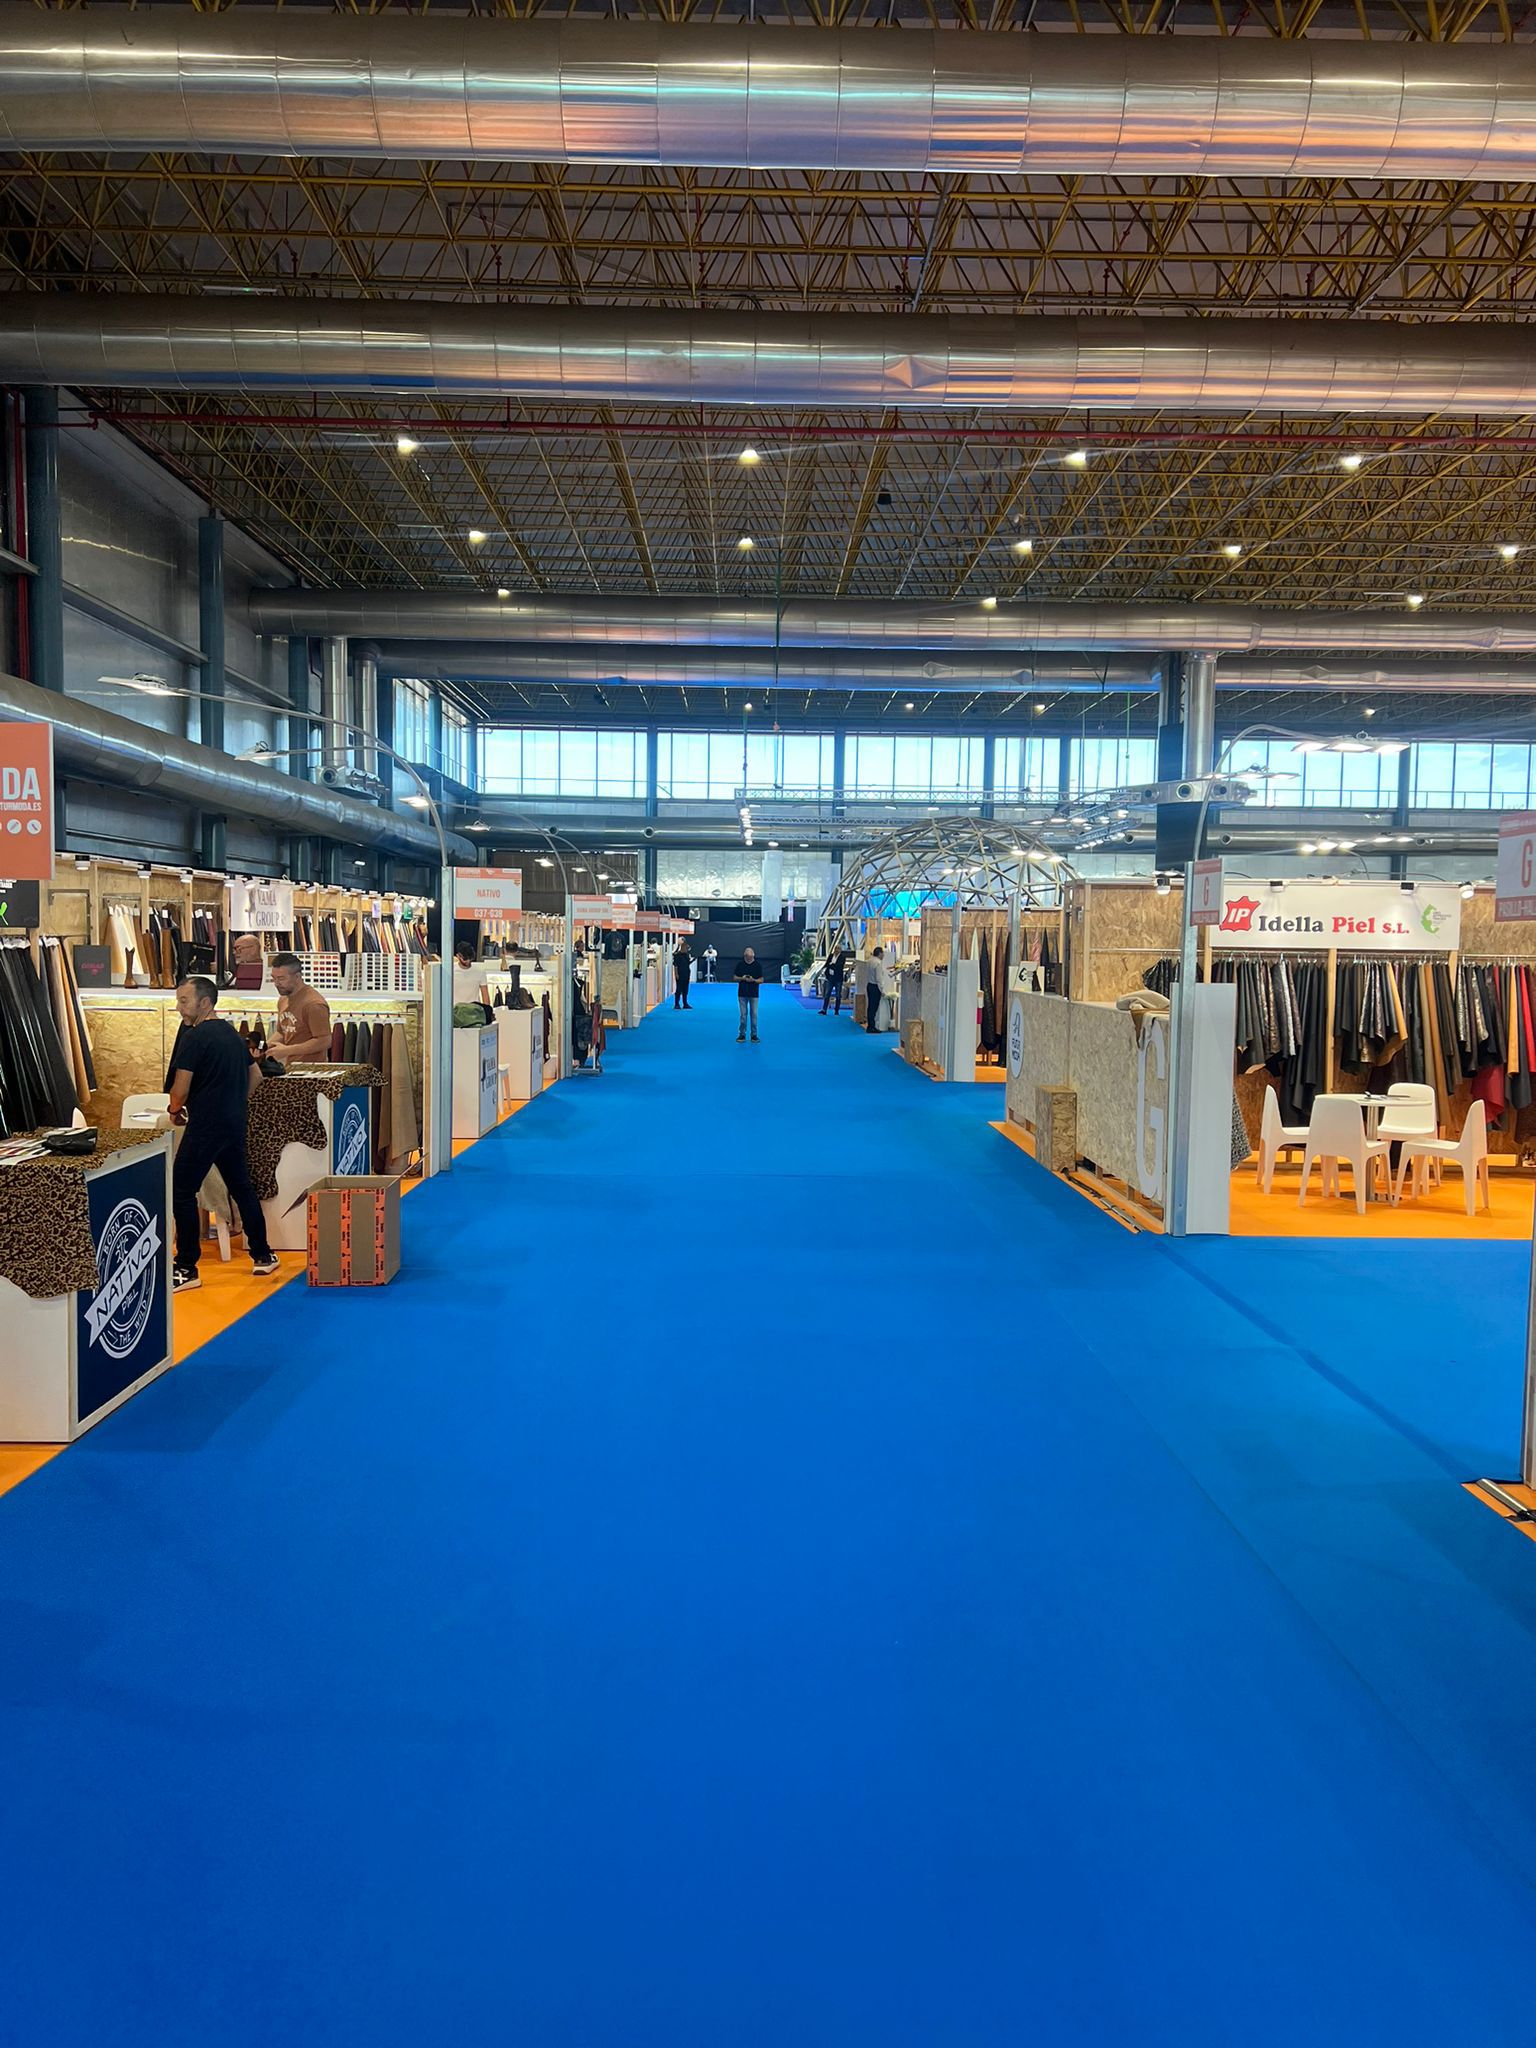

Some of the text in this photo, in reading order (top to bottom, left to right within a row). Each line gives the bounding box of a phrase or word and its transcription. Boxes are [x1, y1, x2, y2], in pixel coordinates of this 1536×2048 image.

[1521, 839, 1534, 888] G
[476, 889, 501, 898] NATIVO
[256, 911, 280, 927] GROUP
[1228, 908, 1251, 923] IP
[1259, 915, 1324, 933] Idella
[1332, 917, 1376, 933] Piel
[102, 1211, 134, 1255] BORN OF
[119, 1330, 131, 1346] THE
